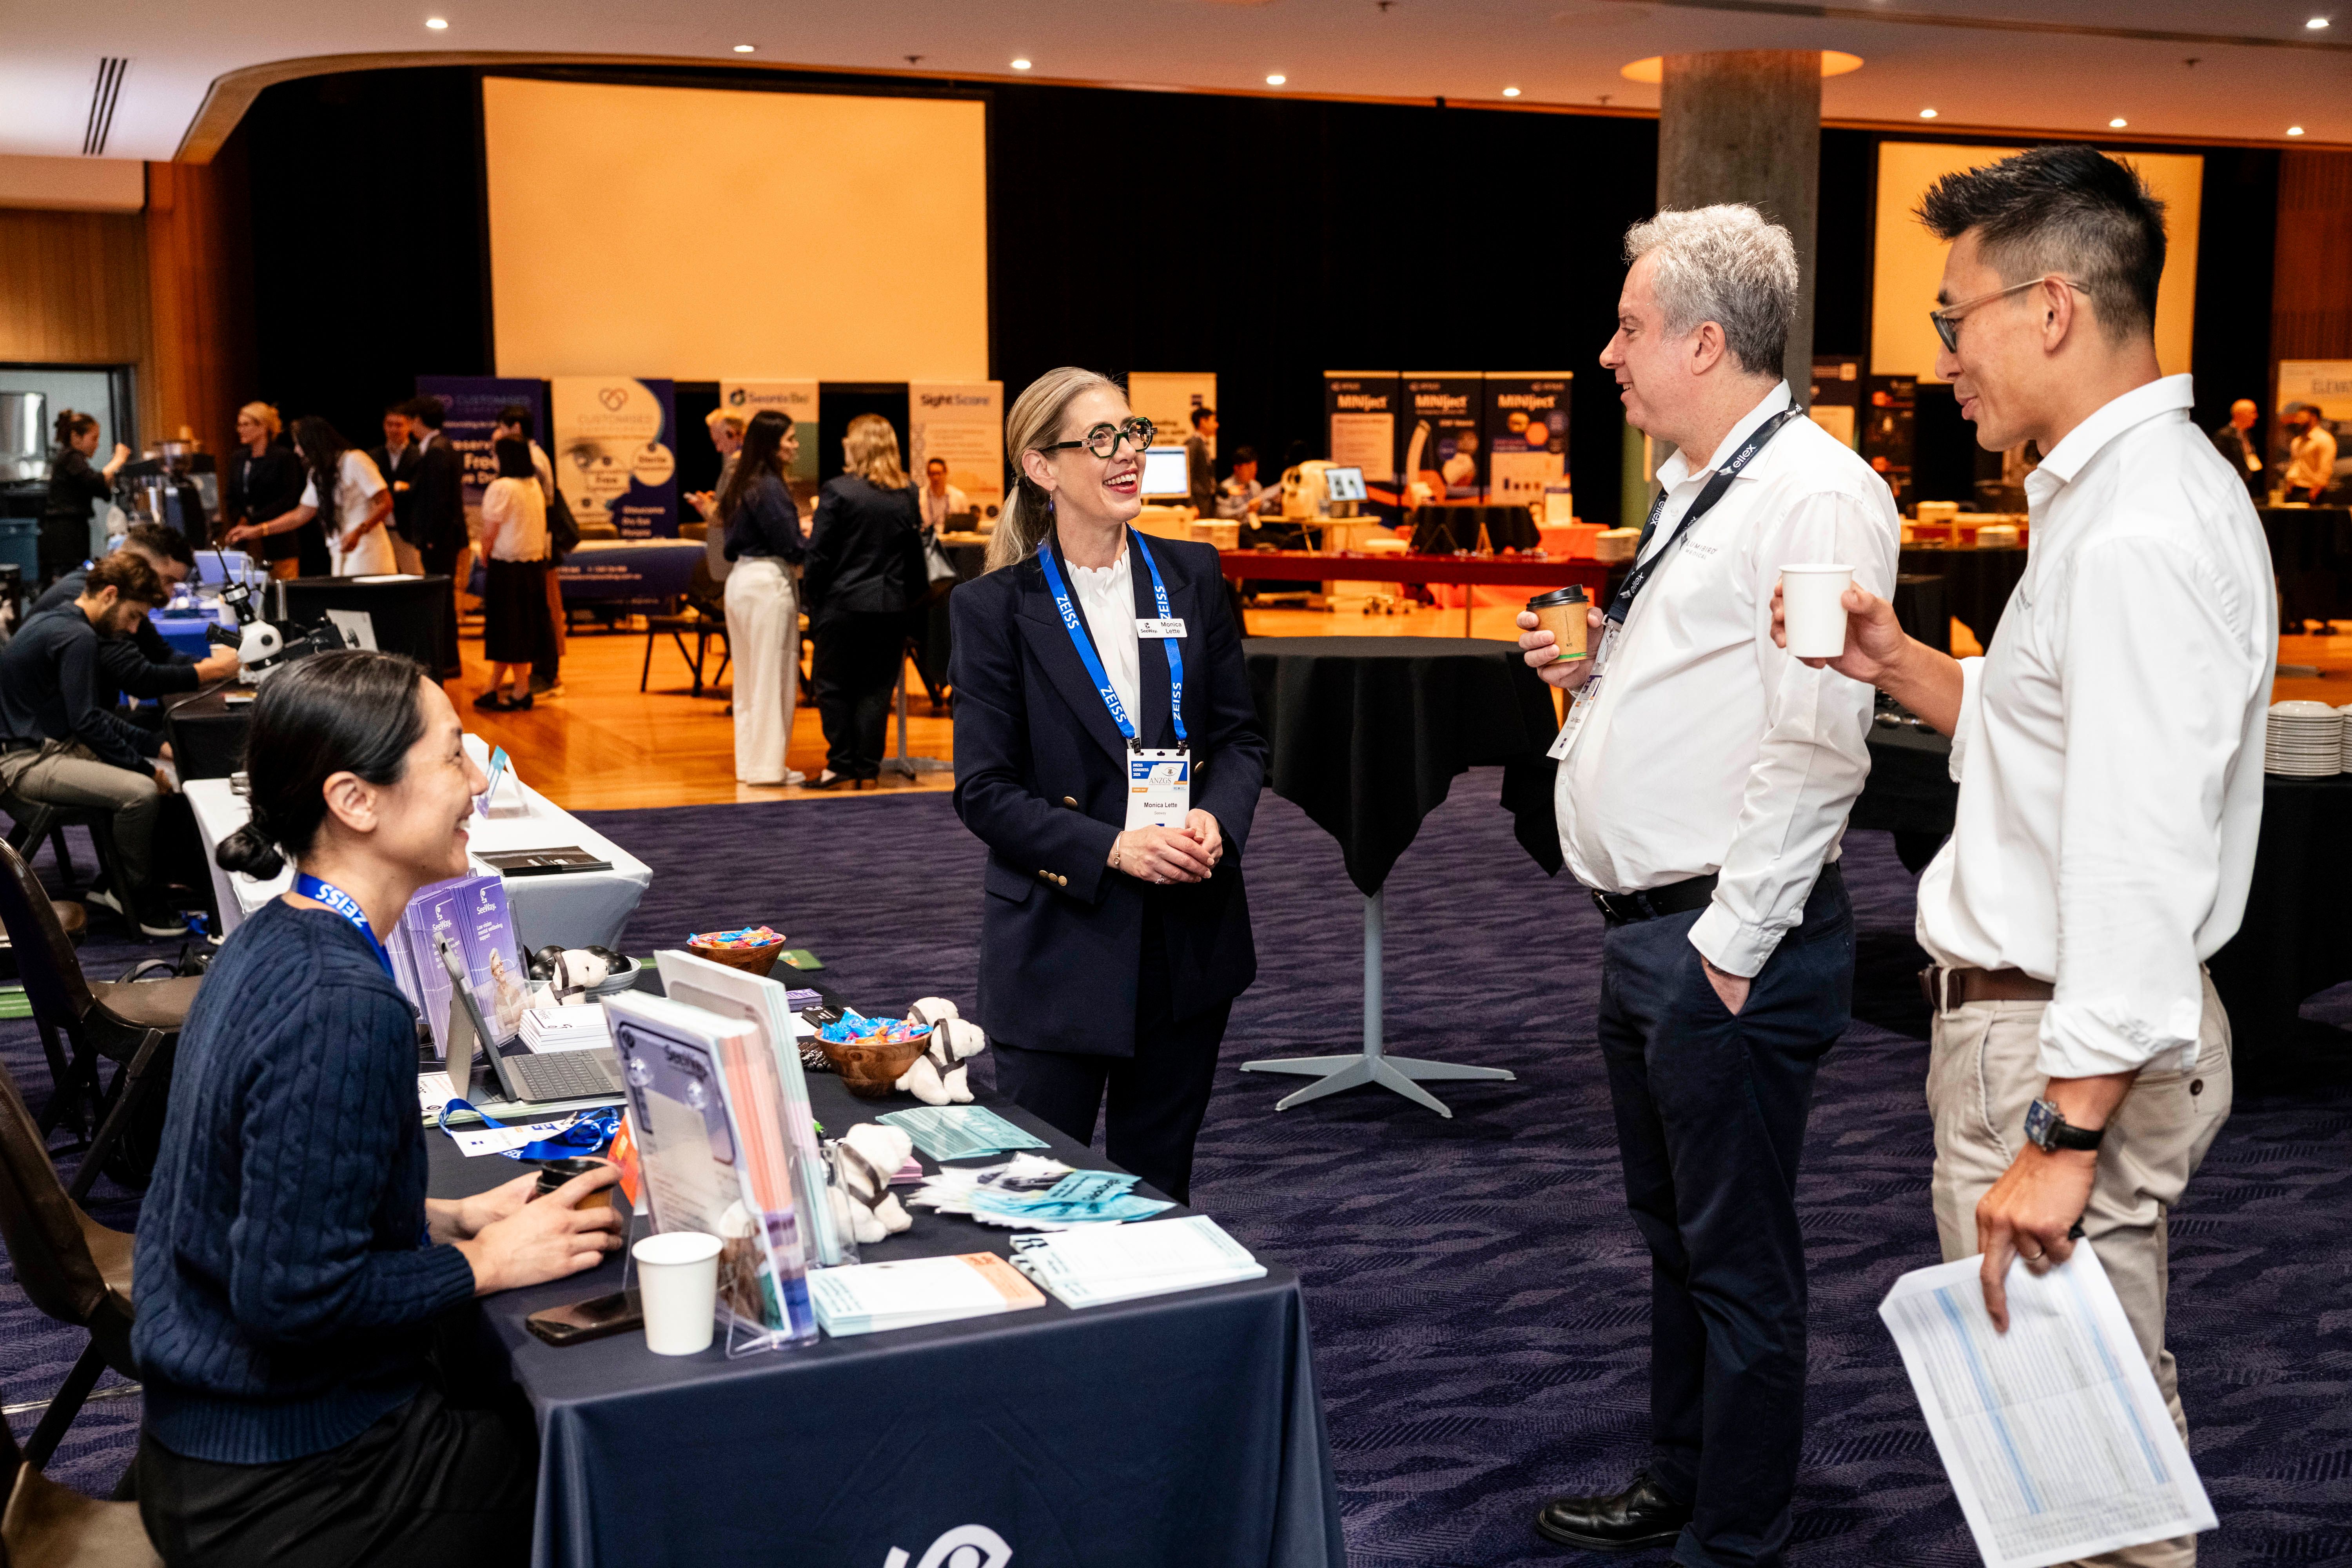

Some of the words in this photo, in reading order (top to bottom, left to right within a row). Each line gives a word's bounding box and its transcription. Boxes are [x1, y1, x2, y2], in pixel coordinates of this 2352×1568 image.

[1733, 444, 1757, 468] ellex
[1686, 549, 1707, 559] MEDICAL
[1631, 572, 1644, 593] ellex
[1056, 593, 1079, 629] ZEISS
[1155, 586, 1171, 619] ZEISS
[1100, 685, 1127, 723] ZEISS
[1172, 682, 1181, 720] ZEISS
[315, 884, 367, 928] ZEISS
